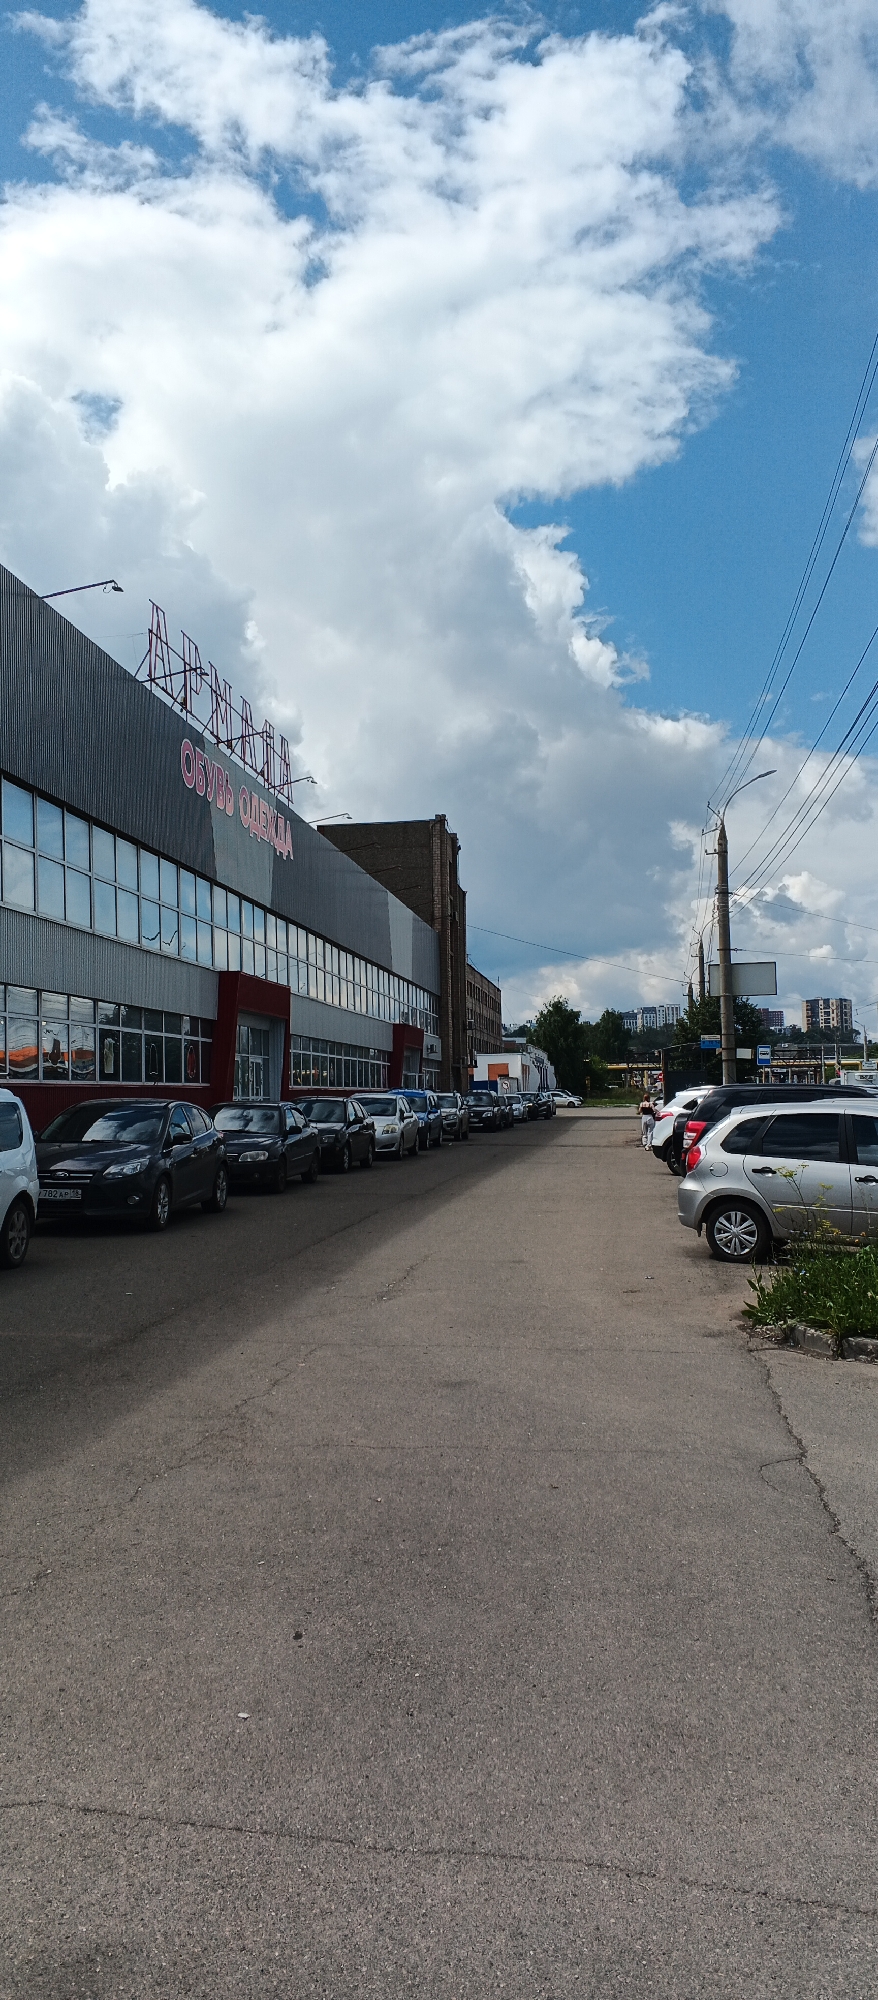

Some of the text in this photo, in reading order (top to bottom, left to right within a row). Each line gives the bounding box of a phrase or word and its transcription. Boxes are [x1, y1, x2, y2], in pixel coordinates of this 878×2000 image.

[148, 599, 294, 805] АРМАДА
[181, 738, 294, 860] ОБУВЬ ОДЕЖДА
